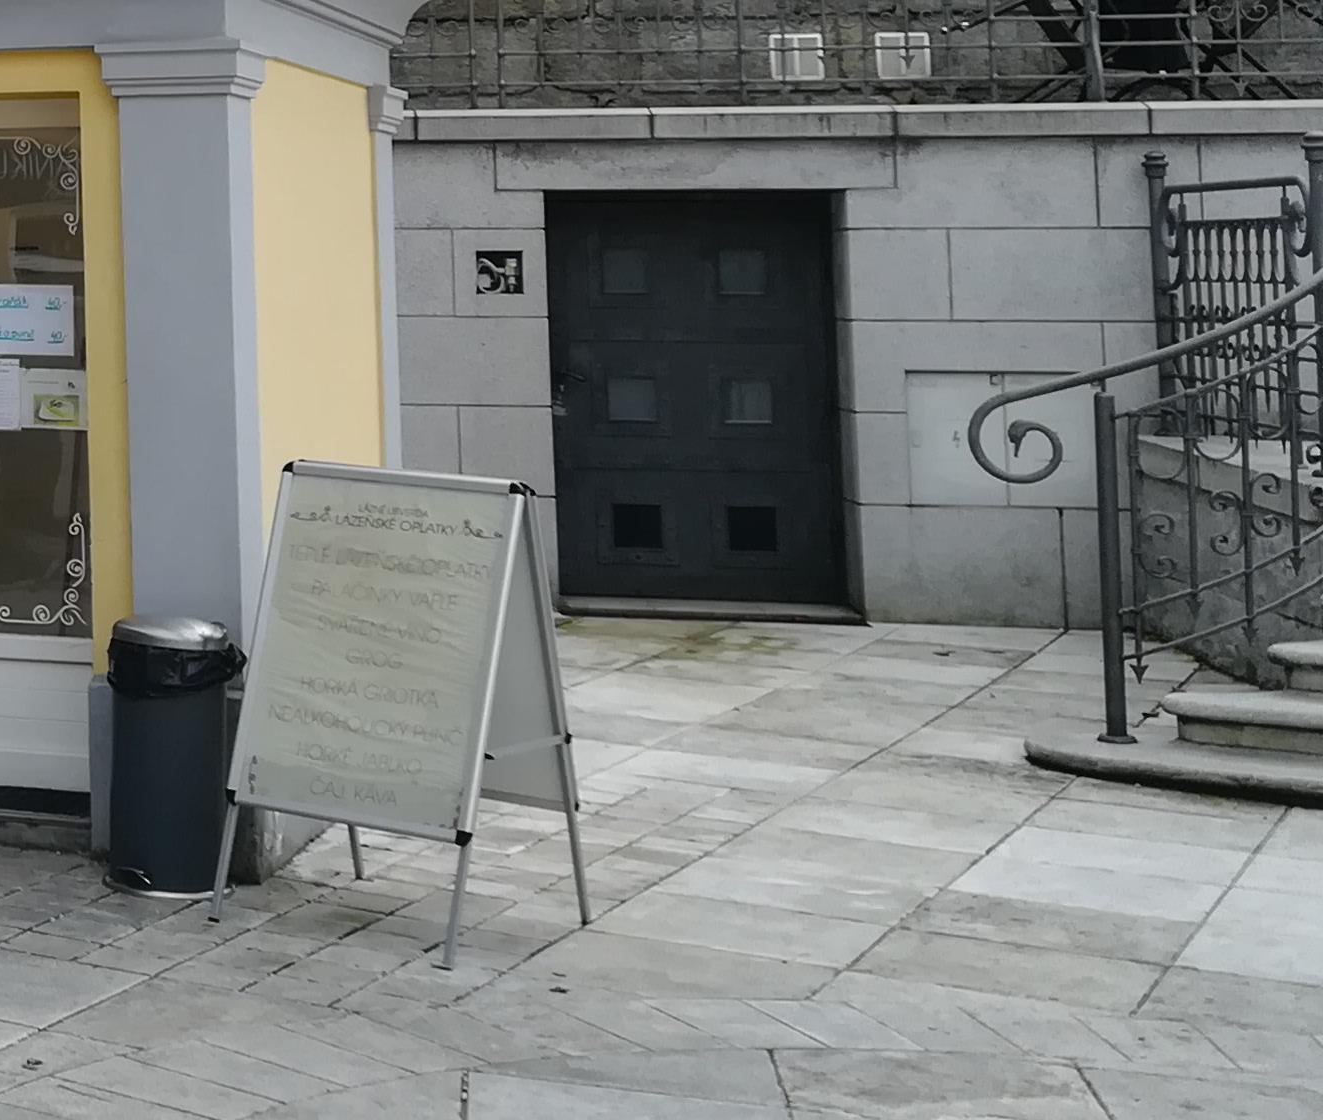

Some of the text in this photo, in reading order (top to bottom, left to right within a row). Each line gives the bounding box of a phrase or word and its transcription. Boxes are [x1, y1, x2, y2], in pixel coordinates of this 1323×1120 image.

[336, 514, 459, 536] LÁZEŇSKÉ OPLATKY
[345, 648, 404, 669] GROG
